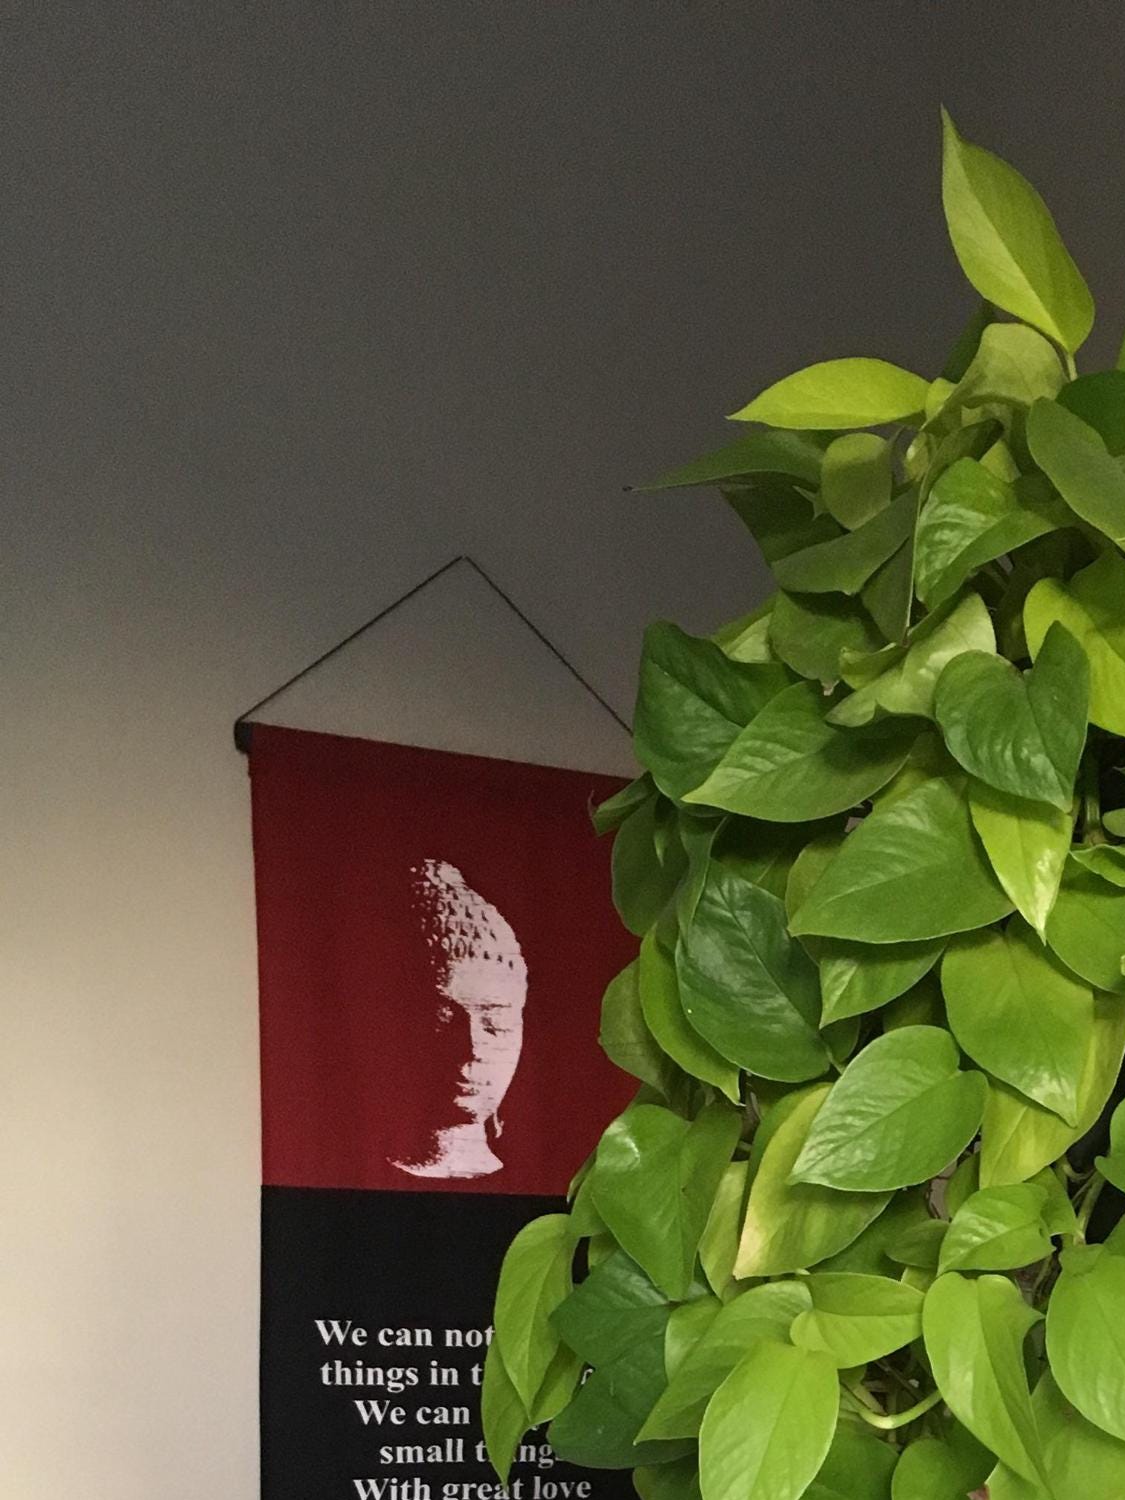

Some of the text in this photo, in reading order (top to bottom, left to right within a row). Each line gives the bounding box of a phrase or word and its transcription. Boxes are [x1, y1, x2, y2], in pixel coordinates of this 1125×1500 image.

[314, 1319, 496, 1347] We can not
[319, 1360, 419, 1393] things
[430, 1360, 459, 1386] in
[354, 1400, 471, 1425] We can
[380, 1438, 560, 1469] small tng
[532, 1476, 592, 1500] love
